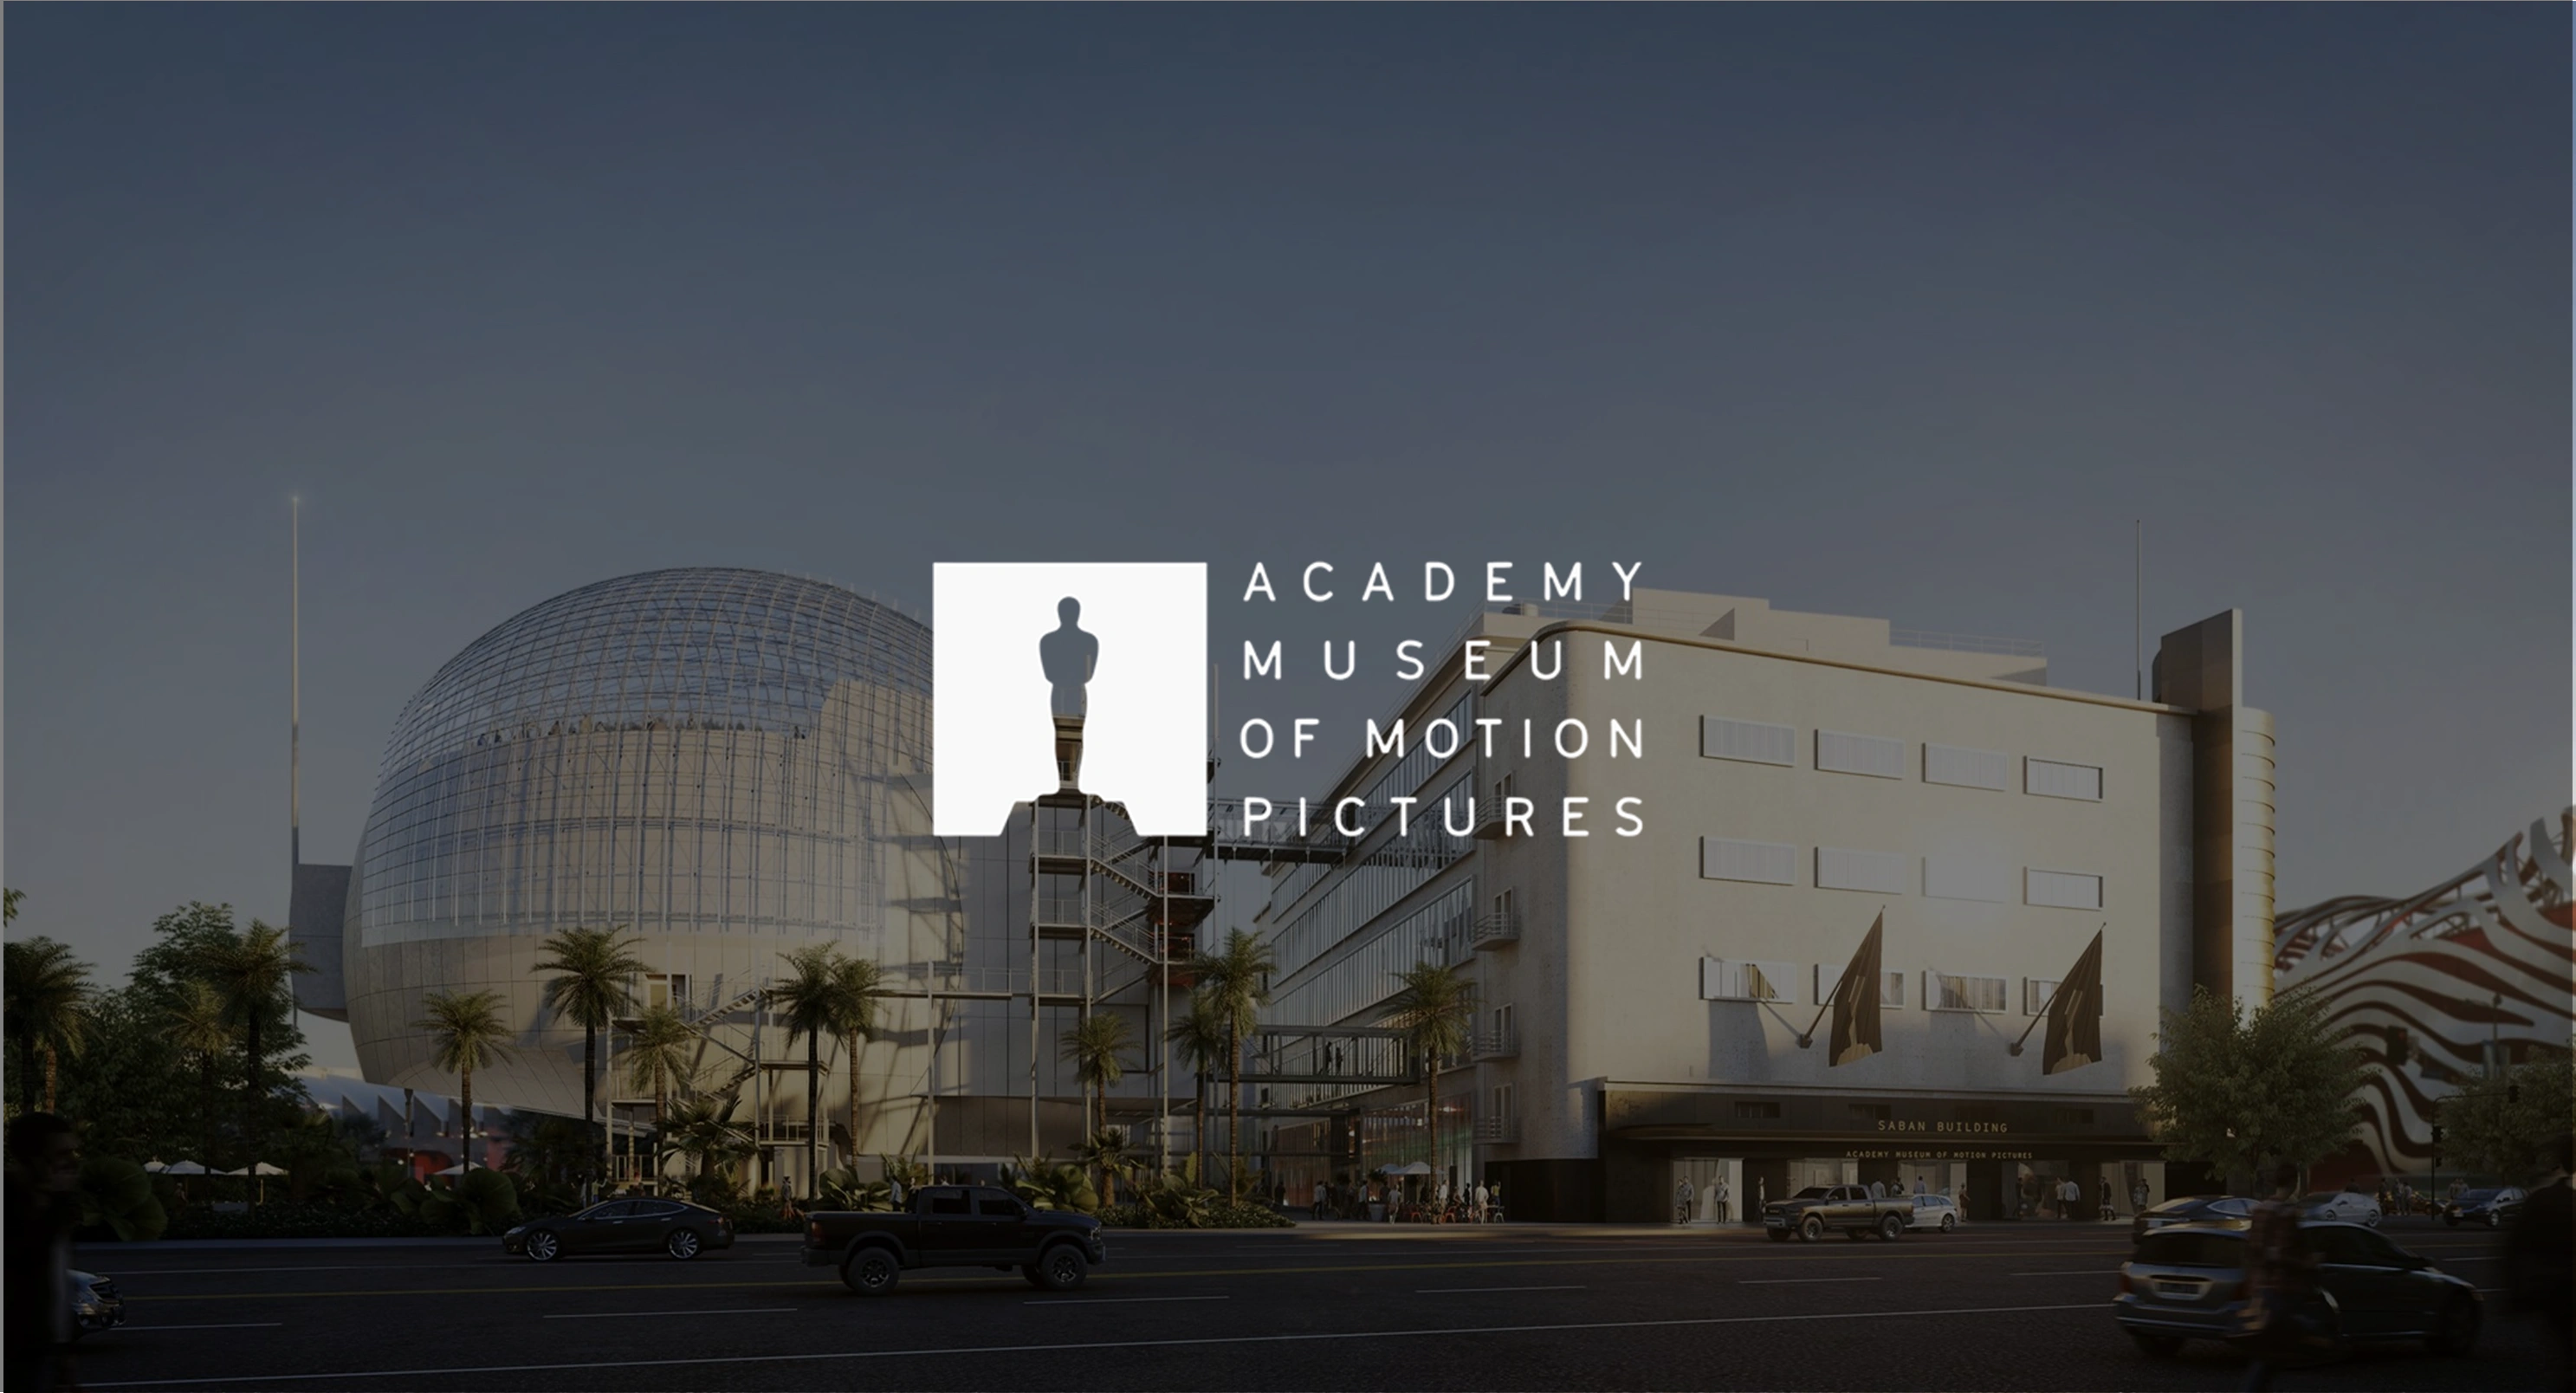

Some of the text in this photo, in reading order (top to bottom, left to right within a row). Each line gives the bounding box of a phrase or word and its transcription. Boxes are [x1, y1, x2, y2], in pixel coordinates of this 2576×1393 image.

[1877, 1120, 2008, 1133] SABAN BUILDING
[1936, 1150, 1948, 1159] OF
[1991, 1151, 2033, 1160] PICTURES
